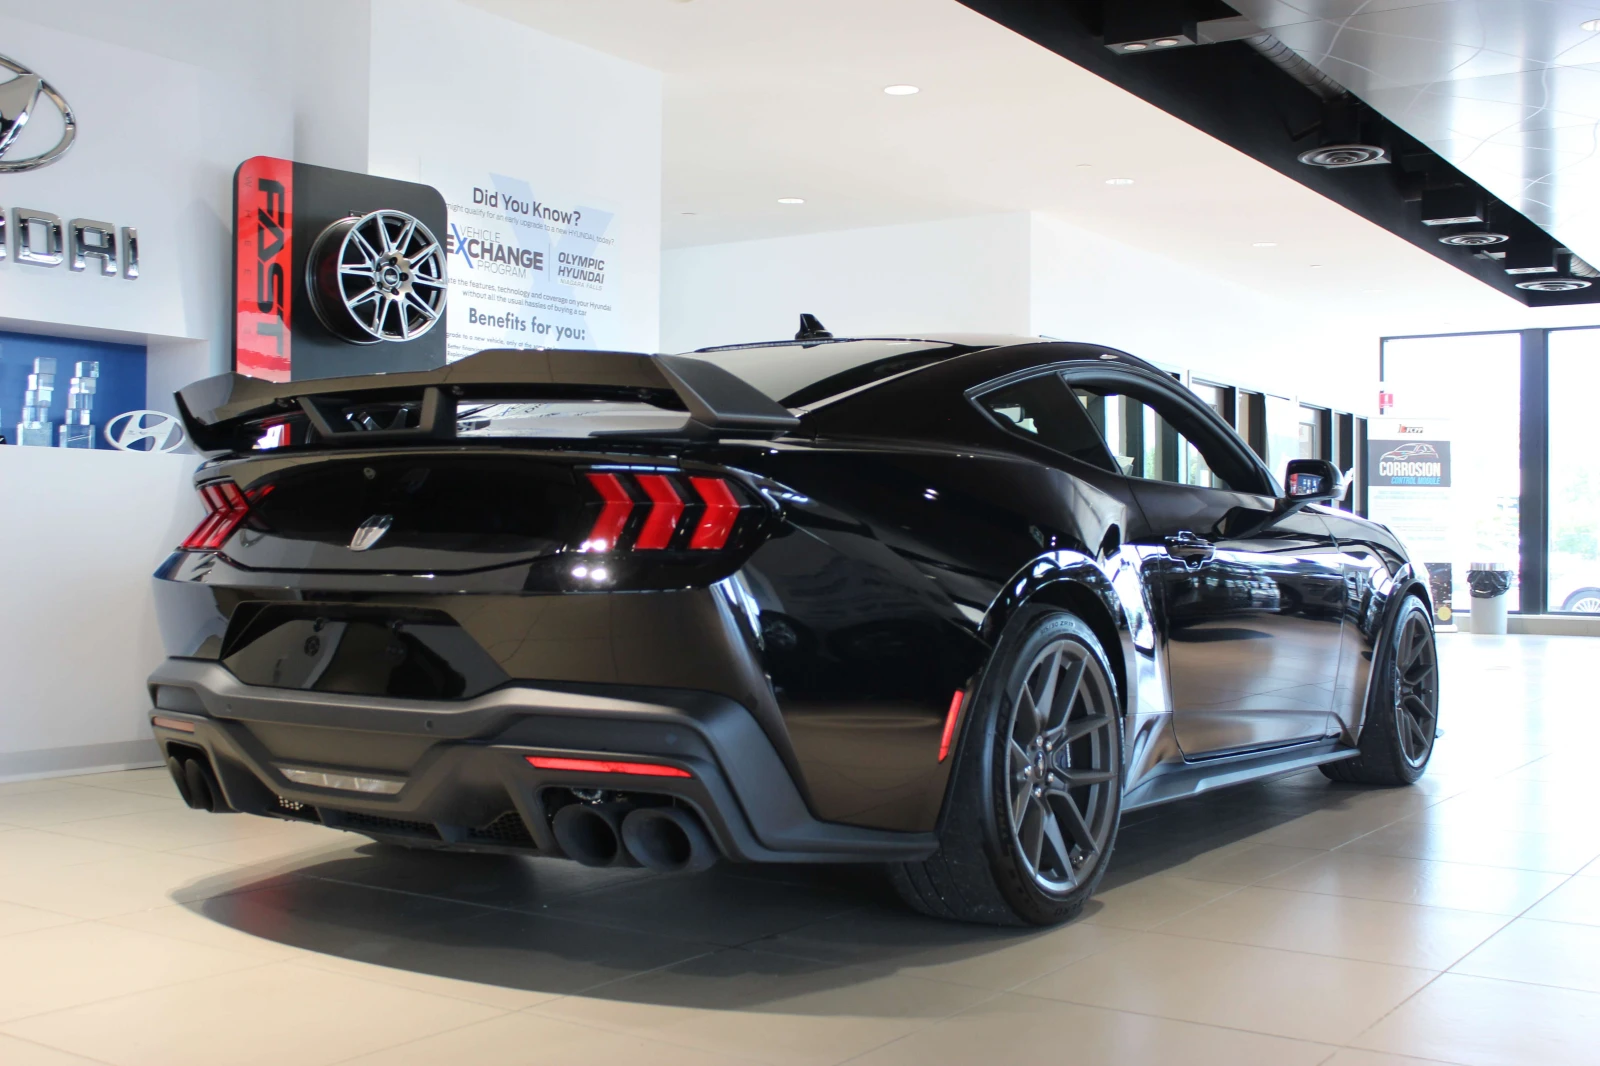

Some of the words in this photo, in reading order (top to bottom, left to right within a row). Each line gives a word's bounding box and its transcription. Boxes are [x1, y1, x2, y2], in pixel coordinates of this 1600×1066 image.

[473, 187, 498, 208] Did
[501, 193, 529, 215] You
[533, 201, 581, 227] Know?
[459, 225, 501, 243] VEHICLE
[464, 207, 486, 219] qualify
[486, 210, 495, 219] for
[504, 215, 520, 226] early
[520, 219, 544, 232] upgrade
[544, 223, 551, 231] to
[555, 227, 568, 235] new
[596, 236, 615, 246] today?
[0, 206, 139, 280] DAI
[447, 223, 544, 271] EXCHANGE
[258, 178, 285, 357] FAST
[477, 260, 527, 279] PROGRAM
[558, 252, 605, 270] OLYMPIC
[557, 266, 605, 284] HYUNDAI
[559, 278, 585, 288] NIAGARA
[586, 283, 603, 291] FALLS
[457, 278, 469, 287] the
[469, 280, 497, 292] features,
[497, 285, 531, 298] technology
[531, 290, 543, 299] and
[542, 295, 568, 306] coverage
[577, 300, 589, 308] your
[589, 302, 612, 312] Hyundai
[462, 290, 487, 300] without
[487, 293, 496, 301] all
[496, 295, 507, 303] the
[507, 296, 524, 305] usual
[524, 300, 547, 310] hassles
[547, 303, 554, 311] of
[554, 305, 573, 316] buying
[469, 307, 527, 331] Benefits
[531, 316, 552, 334] for
[556, 325, 586, 341] you:
[1379, 461, 1442, 477] CORROSION
[1390, 476, 1416, 485] CONTROL
[1417, 476, 1441, 485] MODULE
